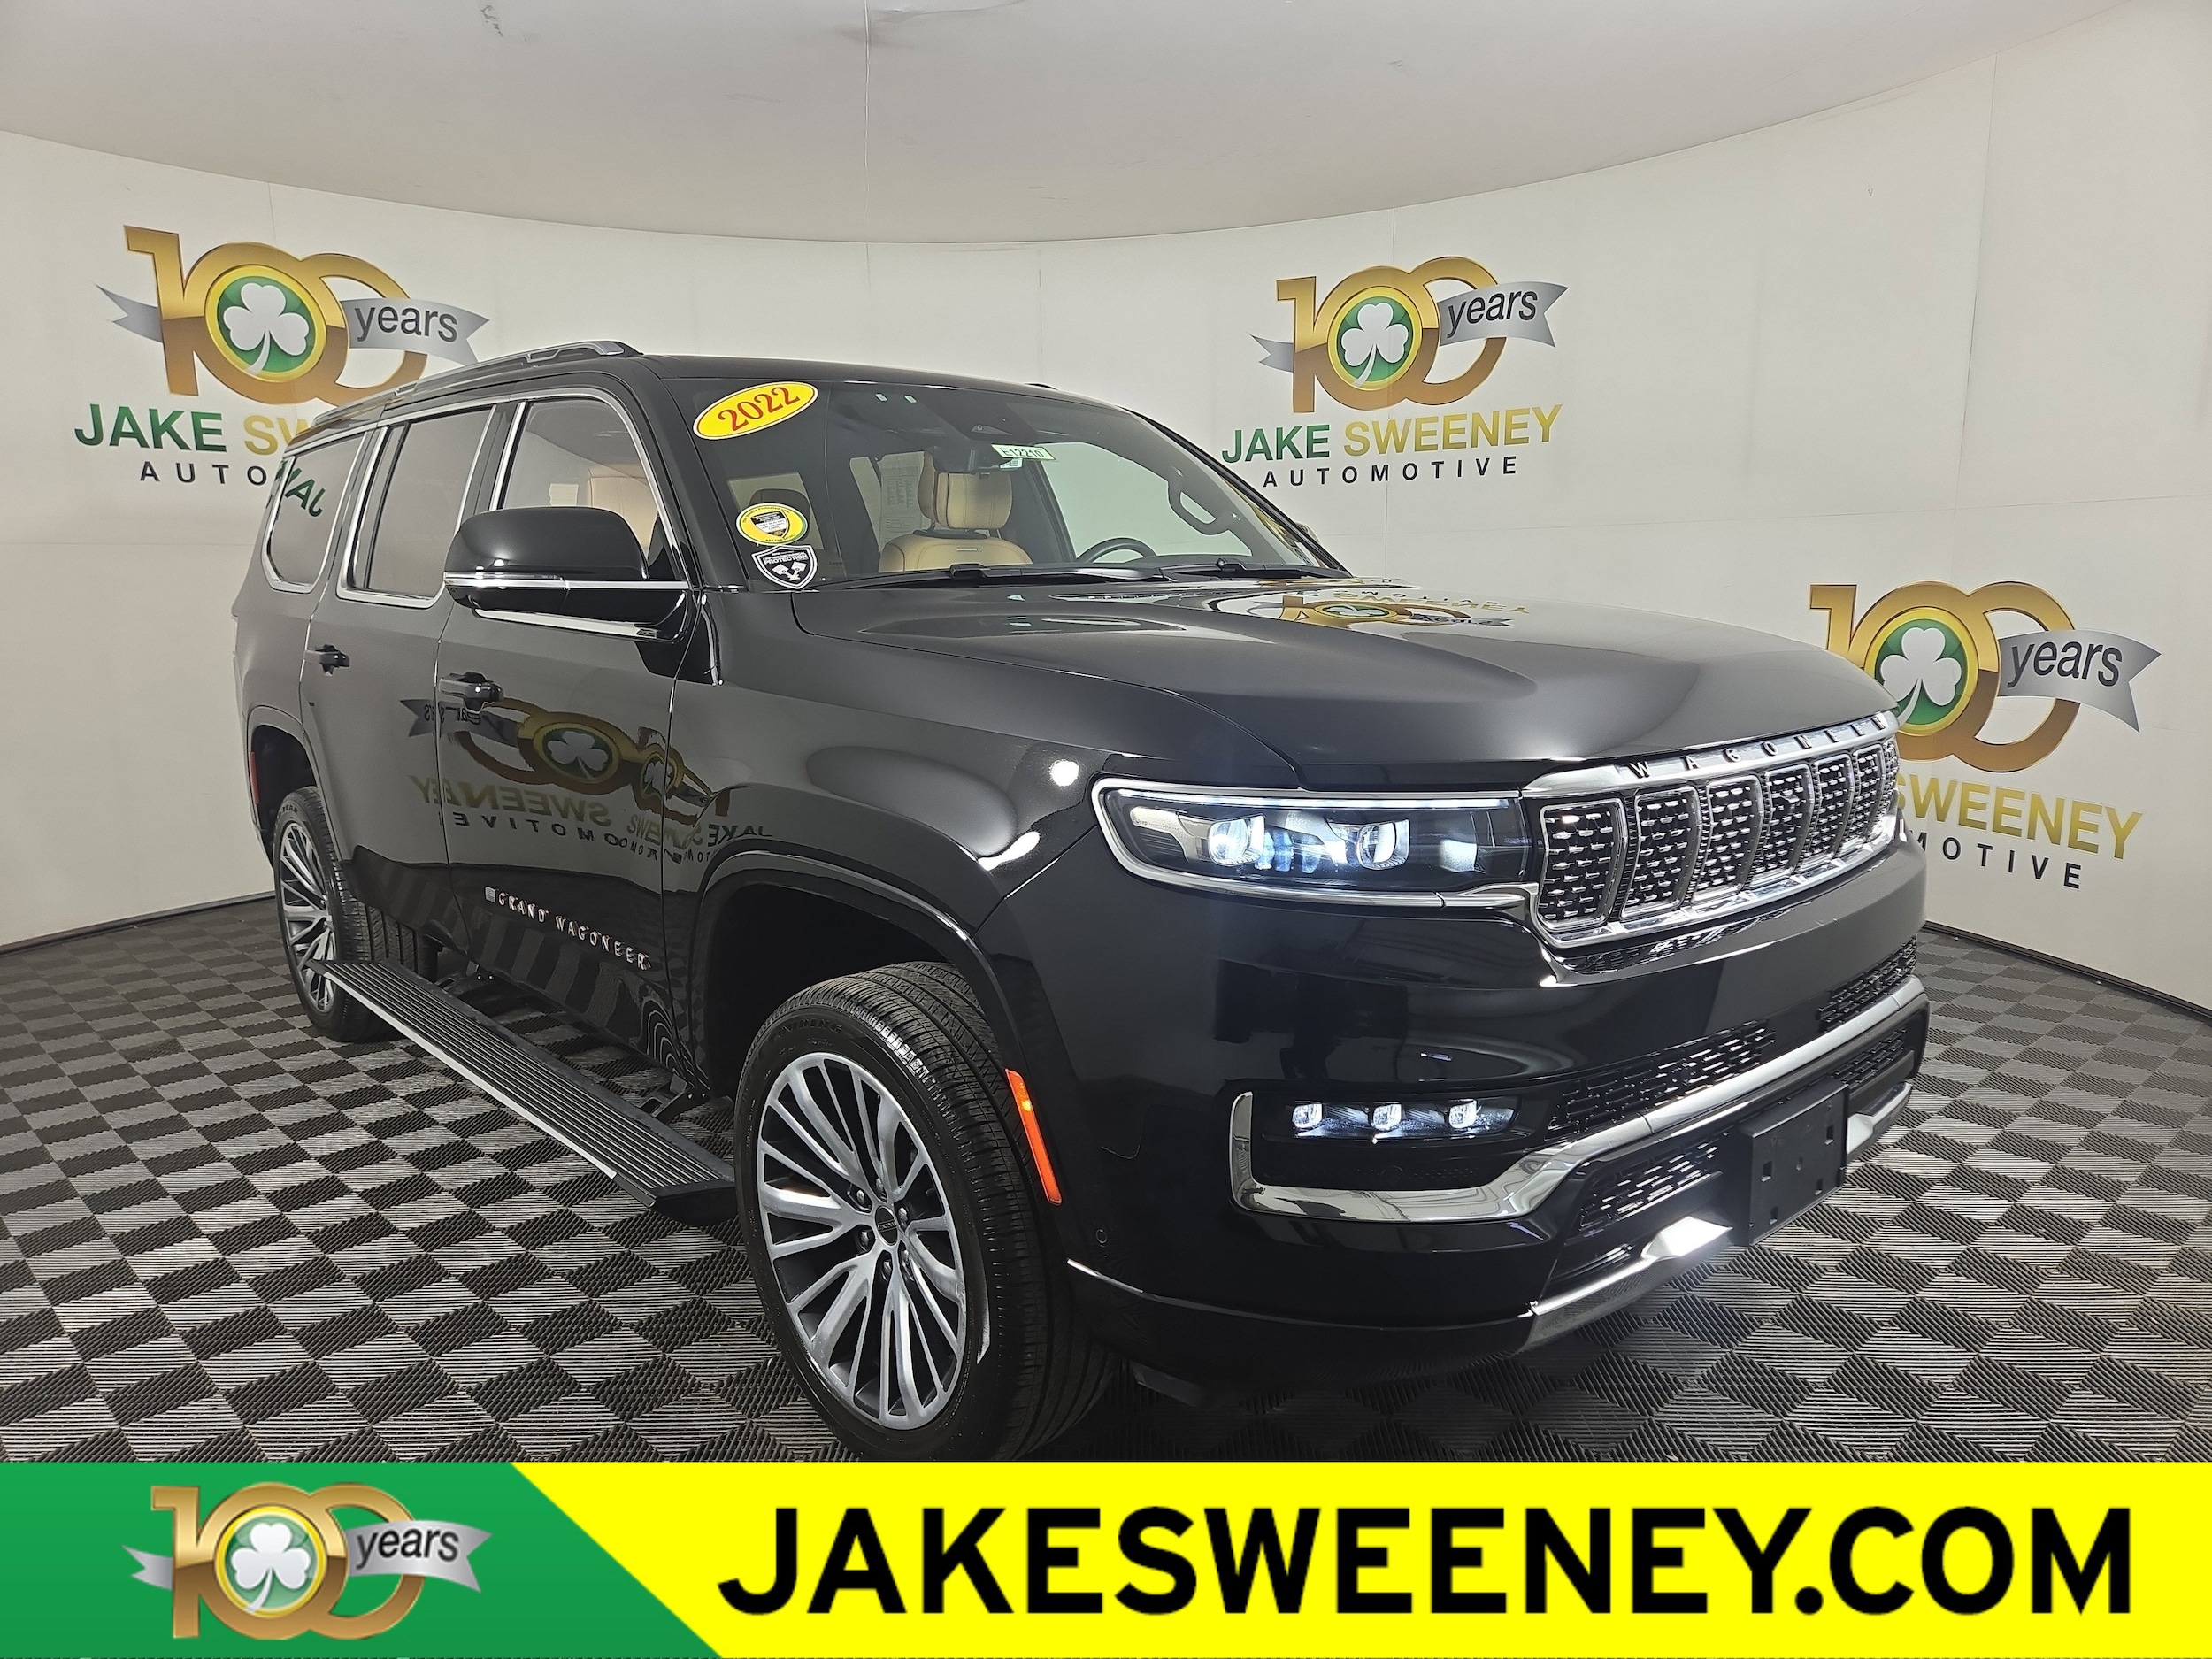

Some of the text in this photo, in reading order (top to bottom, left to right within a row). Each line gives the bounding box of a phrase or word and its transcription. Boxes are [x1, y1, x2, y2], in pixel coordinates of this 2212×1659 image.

[355, 299, 458, 343] years
[1277, 256, 1539, 413] 100 years
[74, 403, 227, 453] JAKE
[718, 387, 801, 432] 2022
[1222, 404, 1563, 464] JAKE SWEENEY
[139, 460, 268, 486] AUTO
[1263, 456, 1518, 488] AUTOMOTIVE
[2006, 640, 2124, 688] years
[498, 892, 651, 971] GRAND WAGONEER
